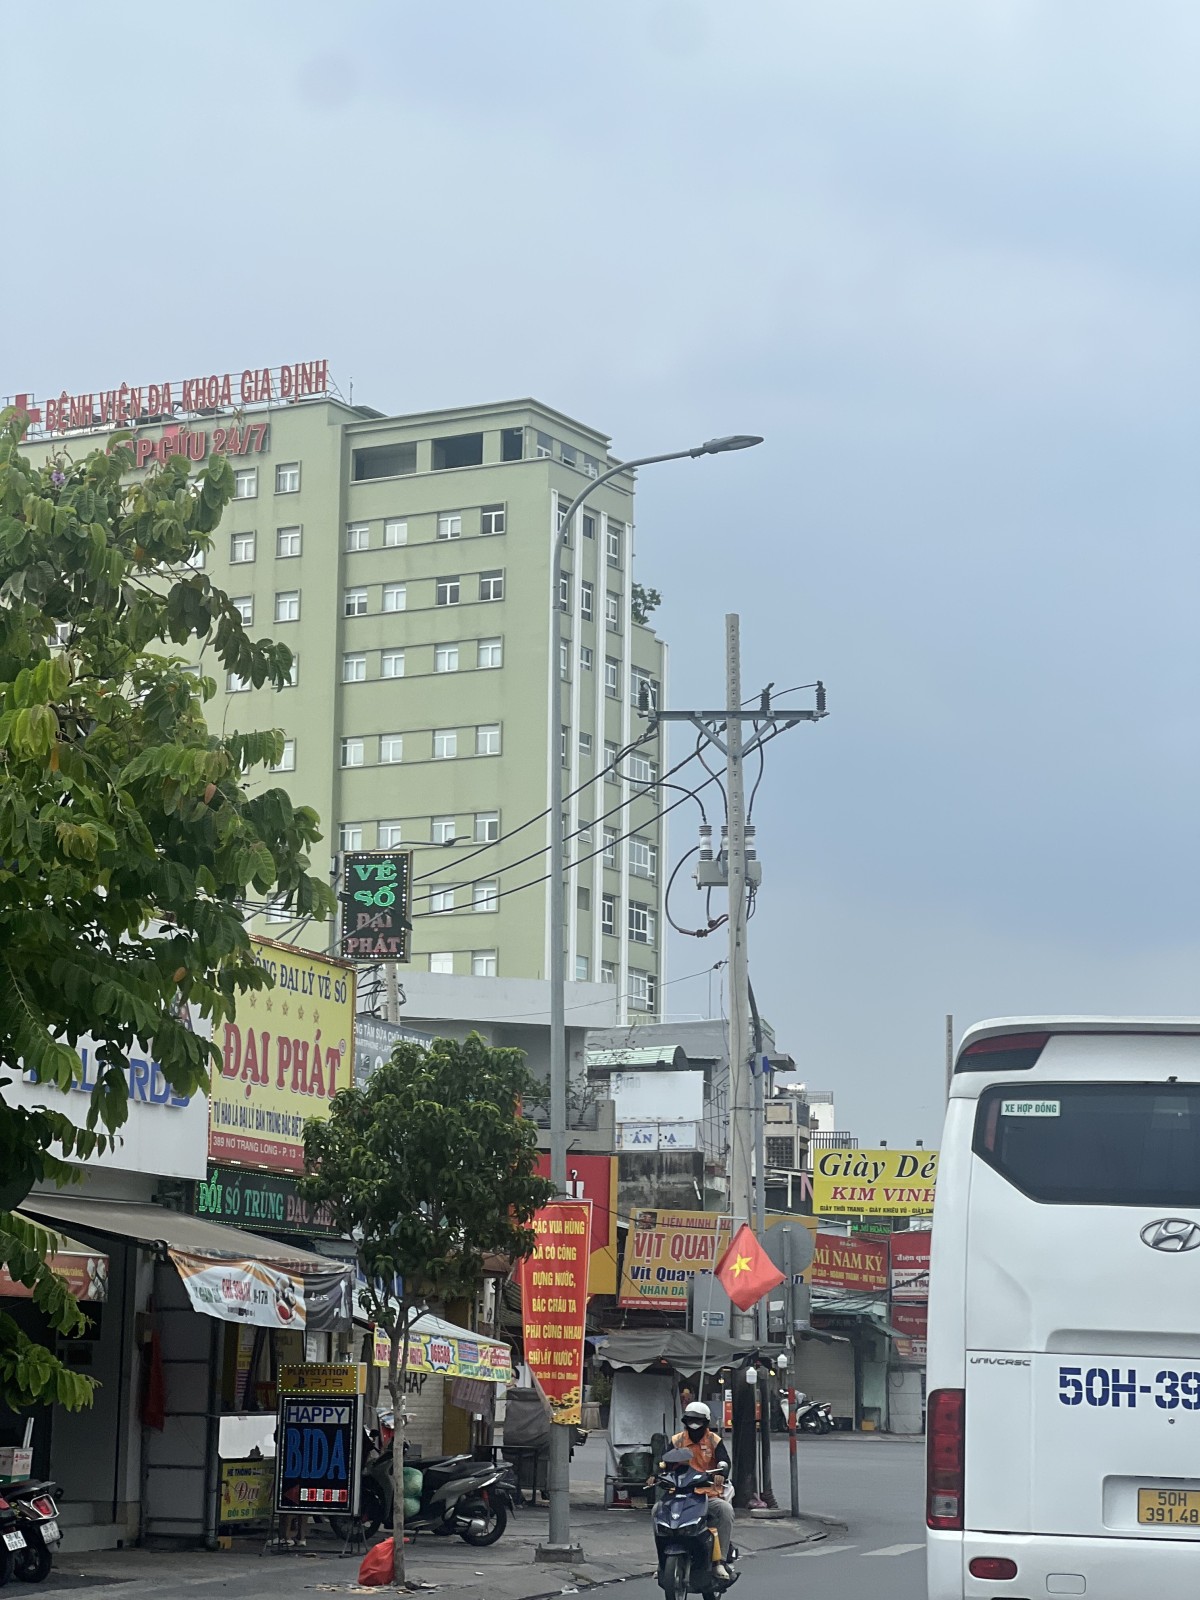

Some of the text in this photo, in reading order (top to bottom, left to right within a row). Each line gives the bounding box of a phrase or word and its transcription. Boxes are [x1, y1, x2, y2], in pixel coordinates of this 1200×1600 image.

[46, 359, 327, 435] BỆNH VIỆN ĐA KHOA GIA ĐỊNH
[347, 933, 400, 953] PHÁT
[280, 964, 299, 996] ĐẠI
[302, 966, 315, 996] LÝ
[318, 970, 331, 1000] VÉ
[335, 971, 347, 1004] SỐ
[222, 1022, 270, 1099] ĐẠI
[276, 1028, 341, 1100] PHÁT
[1005, 1103, 1015, 1113] XE
[1016, 1102, 1033, 1114] HỢP
[236, 1139, 259, 1153] TRANG
[260, 1144, 278, 1156] LONG
[819, 1153, 937, 1185] Giày Dé
[244, 1183, 284, 1220] TRÚNG
[831, 1186, 936, 1202] KIM VINH
[549, 1220, 563, 1234] VUA
[564, 1218, 585, 1234] HÙNG
[686, 1217, 711, 1229] MINH
[545, 1243, 556, 1260] CÓ
[635, 1232, 721, 1263] VỊT QUAY
[833, 1250, 863, 1270] NAM
[533, 1271, 553, 1288] DỰNG
[631, 1266, 652, 1282] Vịt
[532, 1296, 576, 1313] BÁC CHÁU TA
[543, 1321, 562, 1339] CÙNG
[563, 1325, 583, 1340] NHAU
[287, 1368, 349, 1376] PLAYSTATION
[310, 1378, 343, 1387] PS5
[287, 1406, 346, 1424] HAPPY
[285, 1428, 347, 1480] BIDA
[1158, 1492, 1187, 1507] 50H
[1146, 1507, 1199, 1524] 391.48
